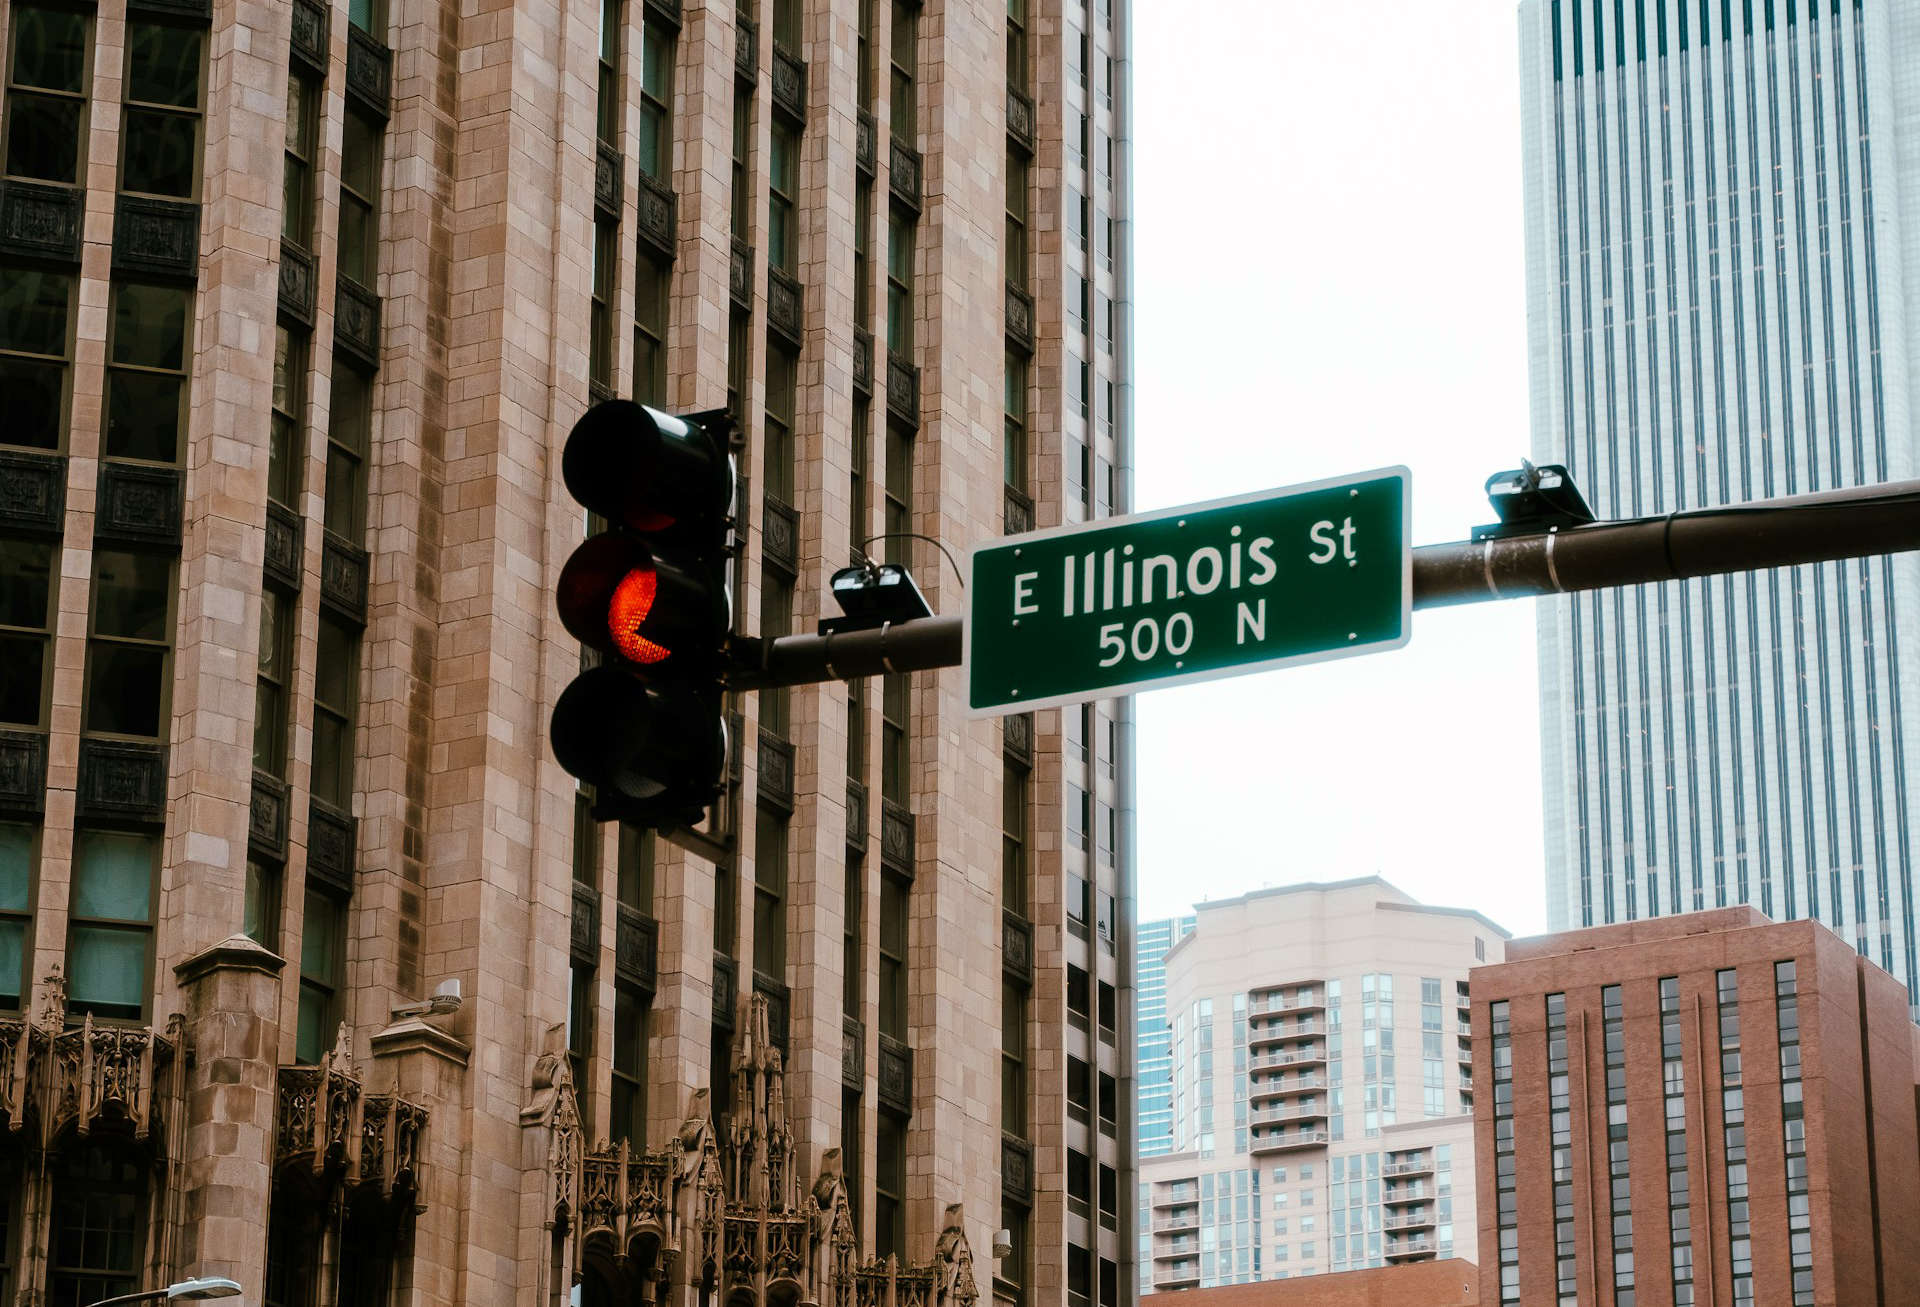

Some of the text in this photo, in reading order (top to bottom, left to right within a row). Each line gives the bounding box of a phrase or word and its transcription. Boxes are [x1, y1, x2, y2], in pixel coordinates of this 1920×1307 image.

[1014, 516, 1357, 617] E Illinois St
[1099, 599, 1266, 667] 500 N
